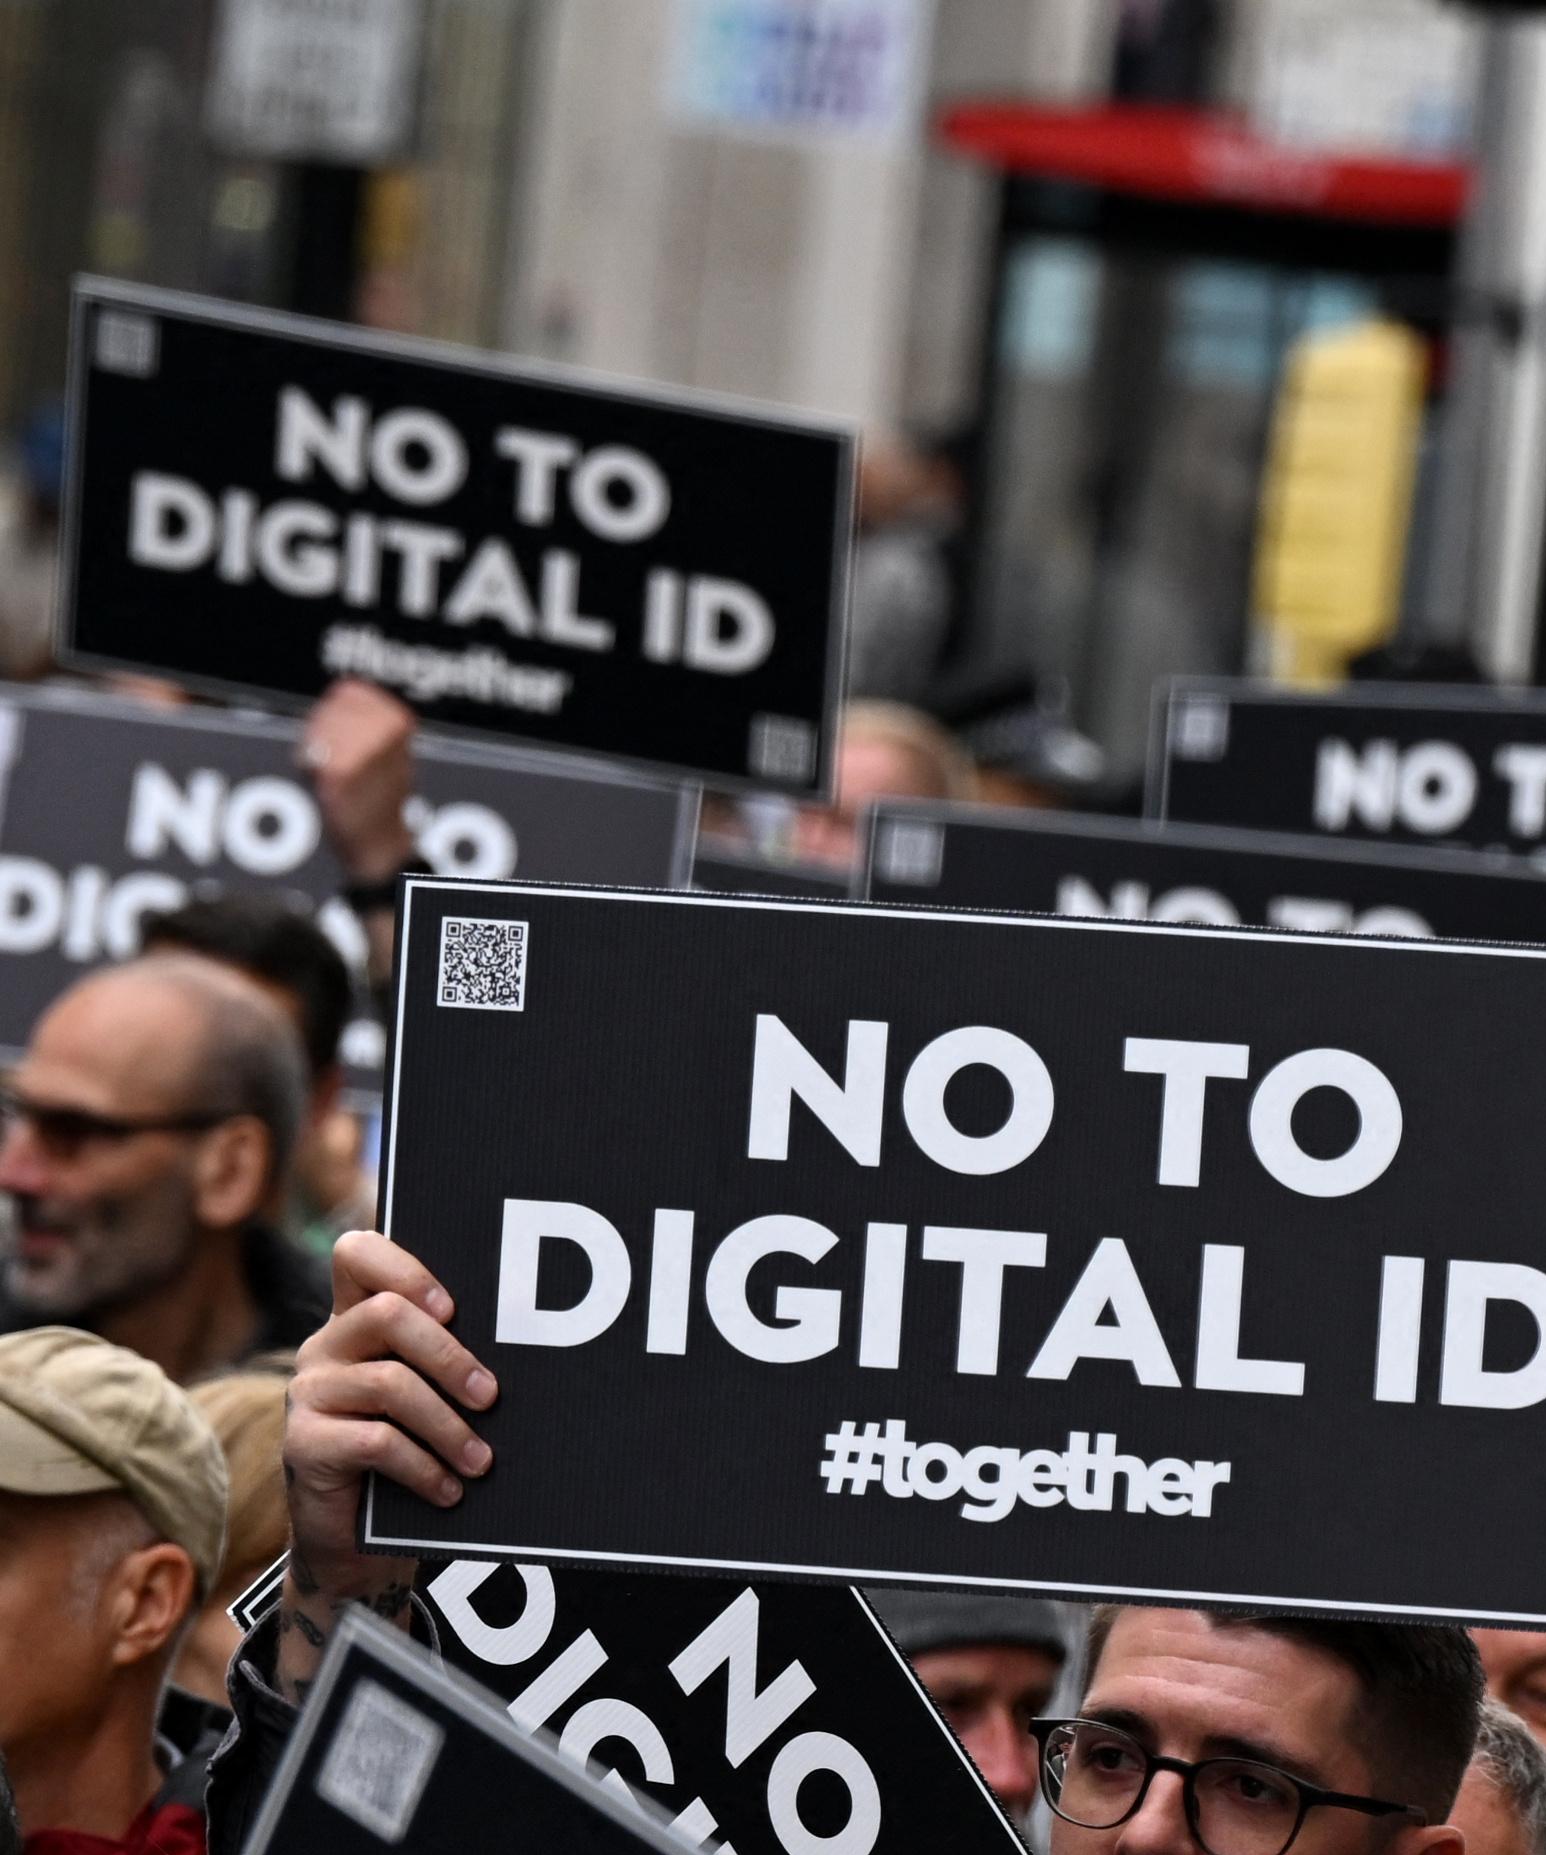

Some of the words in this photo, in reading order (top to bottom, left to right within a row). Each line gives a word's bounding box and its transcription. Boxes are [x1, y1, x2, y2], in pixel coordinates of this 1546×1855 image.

[276, 384, 469, 506] NO
[497, 426, 672, 542] TO
[127, 470, 615, 651] DIGITAL
[643, 569, 776, 674] ID
[322, 622, 570, 715] #together
[126, 760, 322, 876] NO
[1314, 736, 1476, 834] NO
[747, 1013, 1055, 1176] NO
[1123, 1035, 1403, 1198] TO
[495, 1197, 1307, 1398] DIGITAL
[819, 1418, 1232, 1524] #together
